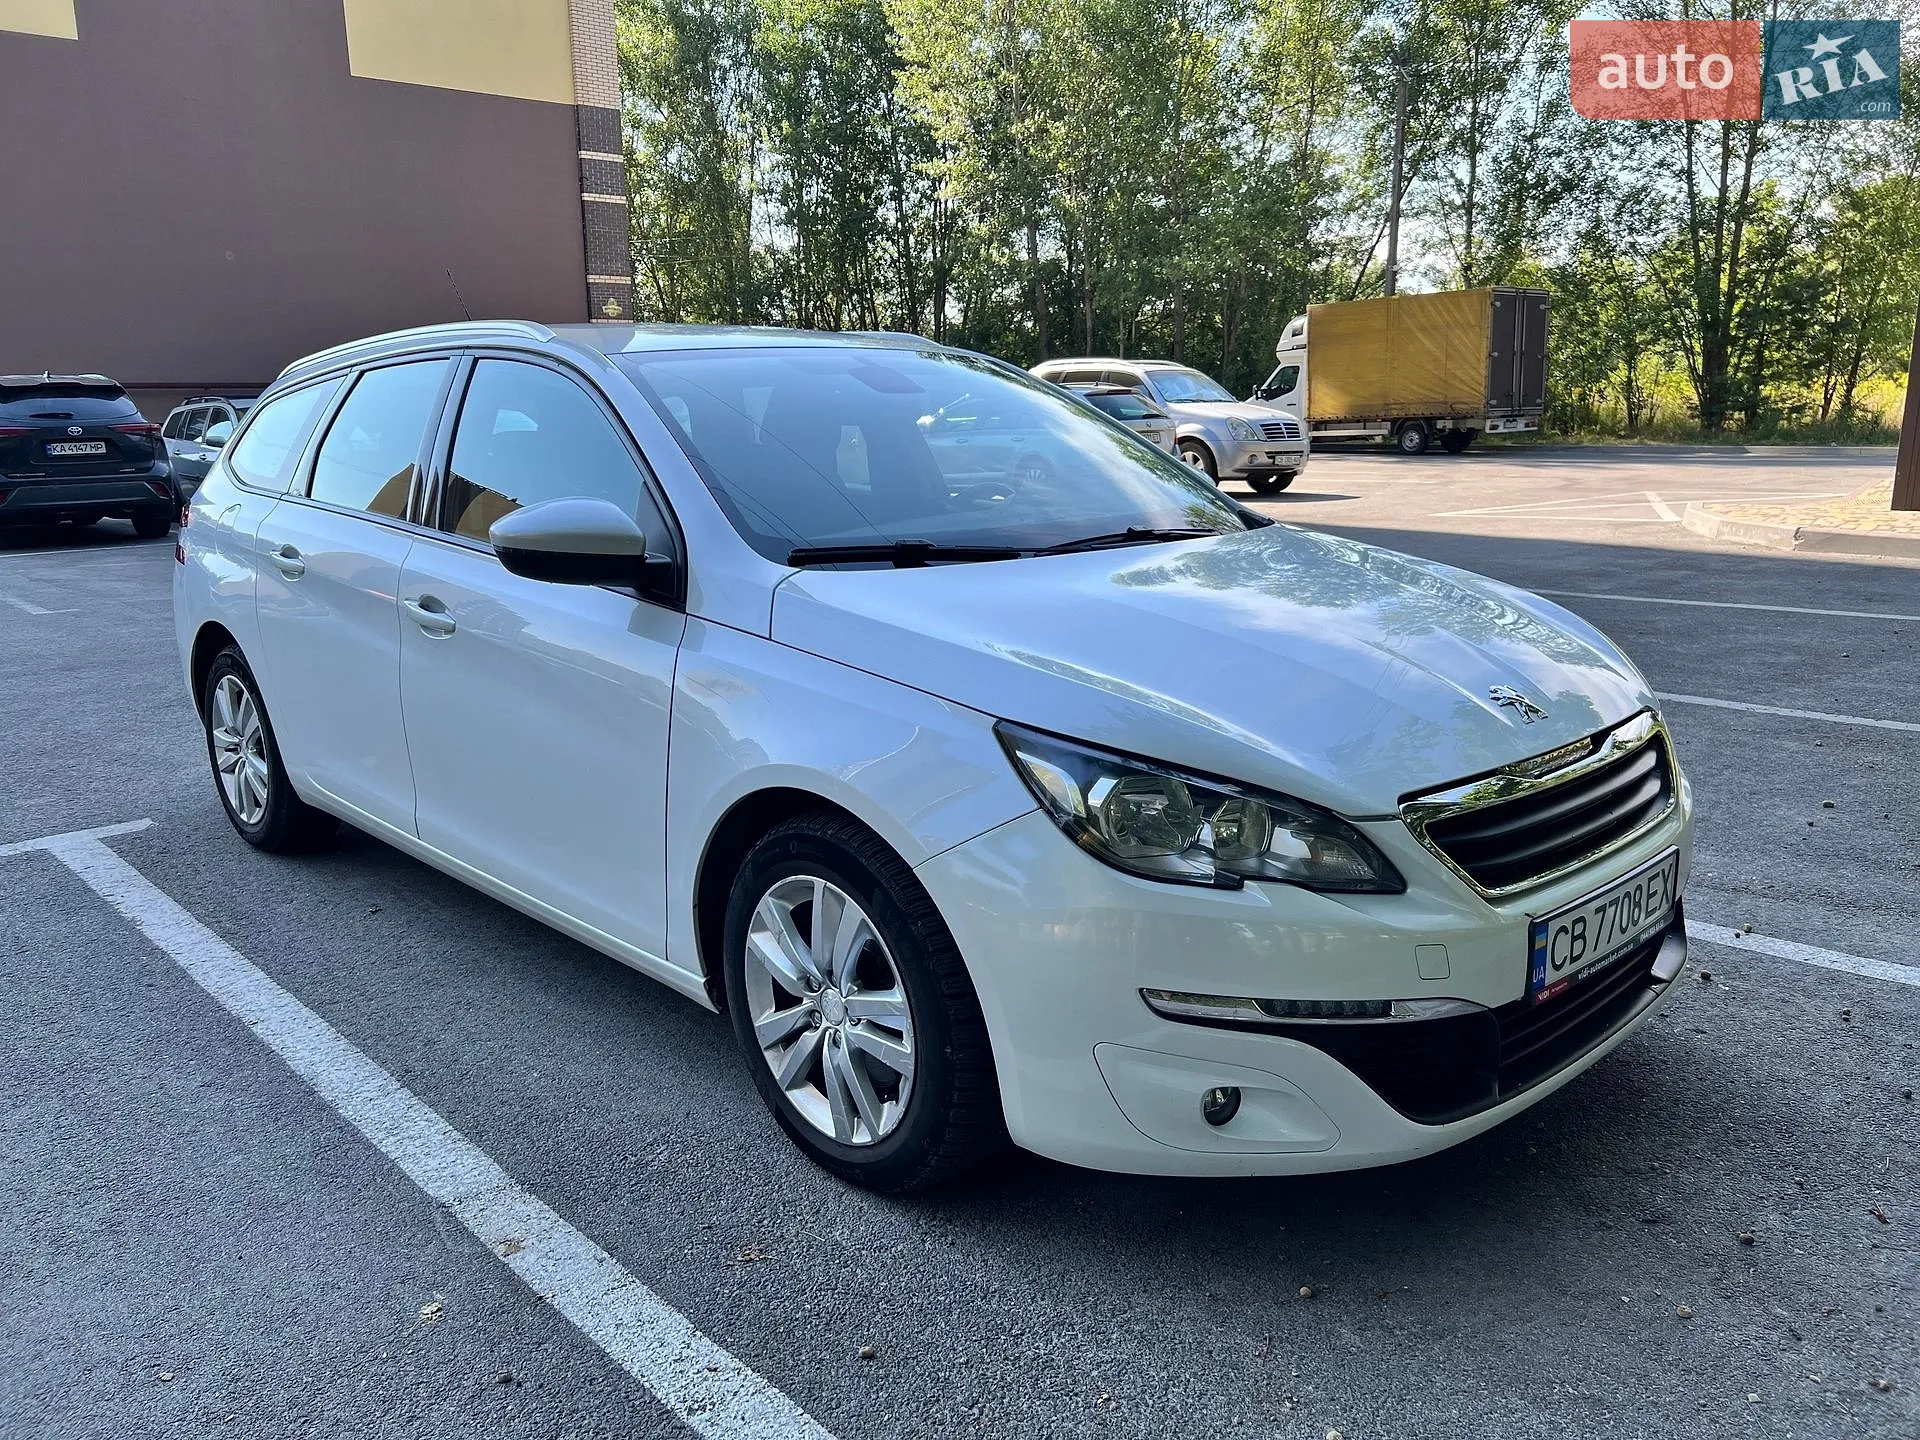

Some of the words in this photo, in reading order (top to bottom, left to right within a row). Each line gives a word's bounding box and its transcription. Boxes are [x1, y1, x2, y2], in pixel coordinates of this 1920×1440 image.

[52, 444, 67, 454] KA
[68, 443, 88, 453] 4147
[89, 443, 103, 452] MP
[1551, 915, 1587, 972] CB
[1593, 883, 1643, 952] 7708
[1645, 863, 1673, 921] EX
[1533, 965, 1545, 983] UA
